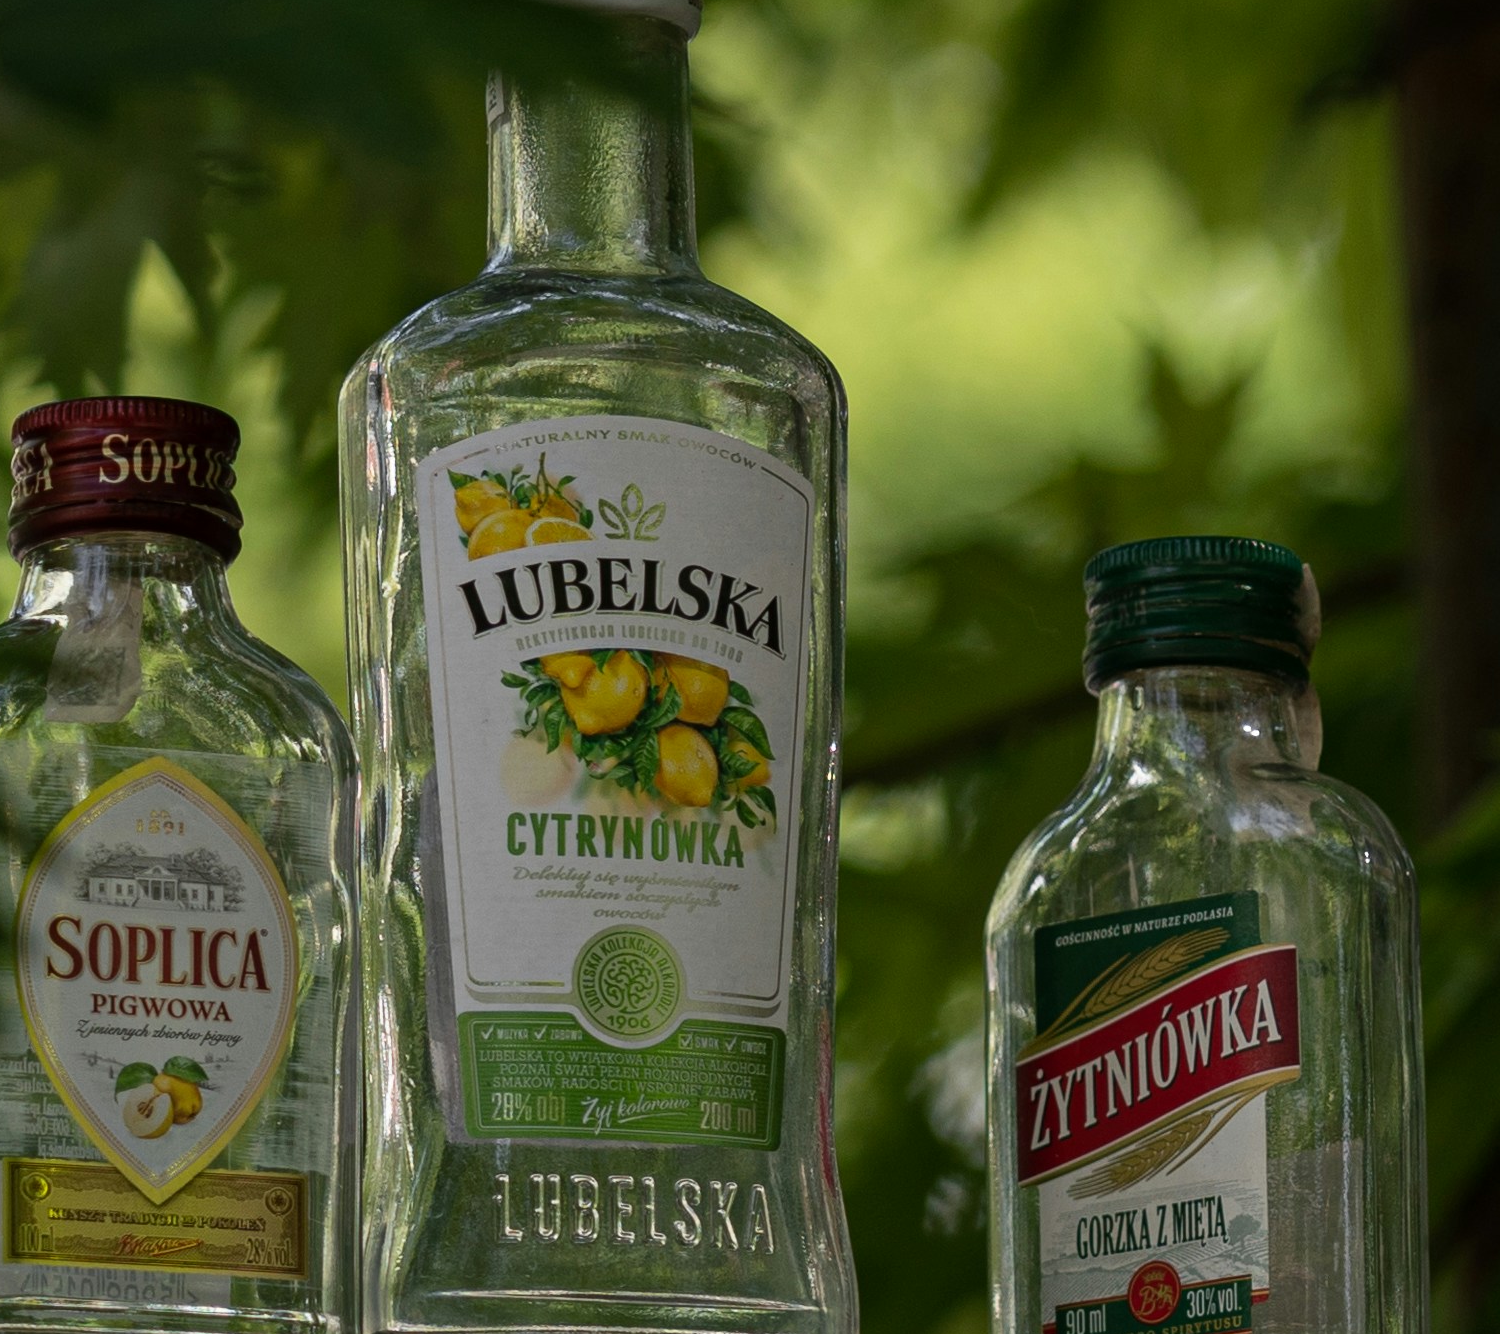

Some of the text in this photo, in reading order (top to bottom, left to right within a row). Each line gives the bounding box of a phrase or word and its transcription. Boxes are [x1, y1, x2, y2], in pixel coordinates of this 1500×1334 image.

[99, 433, 235, 491] SOPLIC
[495, 429, 757, 469] NATURALNY SMAK OWOCÓW
[457, 556, 788, 660] LUBELSKA
[506, 811, 745, 869] CYTRYNÓWKA
[1055, 906, 1234, 948] GOŚCINNOŚĆ W NATURZE PODLASIA
[46, 914, 270, 993] SOPLICA
[91, 993, 233, 1023] PIGWOWA
[607, 1015, 651, 1028] 1906
[479, 1049, 544, 1062] LUBELSKA
[547, 1050, 566, 1063] TO
[1030, 978, 1283, 1152] ŻYTNIÓWKA
[580, 1095, 615, 1135] Żyj
[700, 1100, 757, 1135] 200 ml
[48, 1206, 108, 1224] KUNSZT
[197, 1216, 267, 1232] POKOLEŃ
[493, 1172, 775, 1255] LUBELSKA
[1076, 1195, 1229, 1260] GORZKA Z MIĘTĄ
[20, 1224, 40, 1251] 100
[246, 1237, 295, 1267] 28% vol.
[1088, 1304, 1107, 1333] ml
[1186, 1286, 1216, 1319] 30%
[1217, 1282, 1243, 1313] vol.
